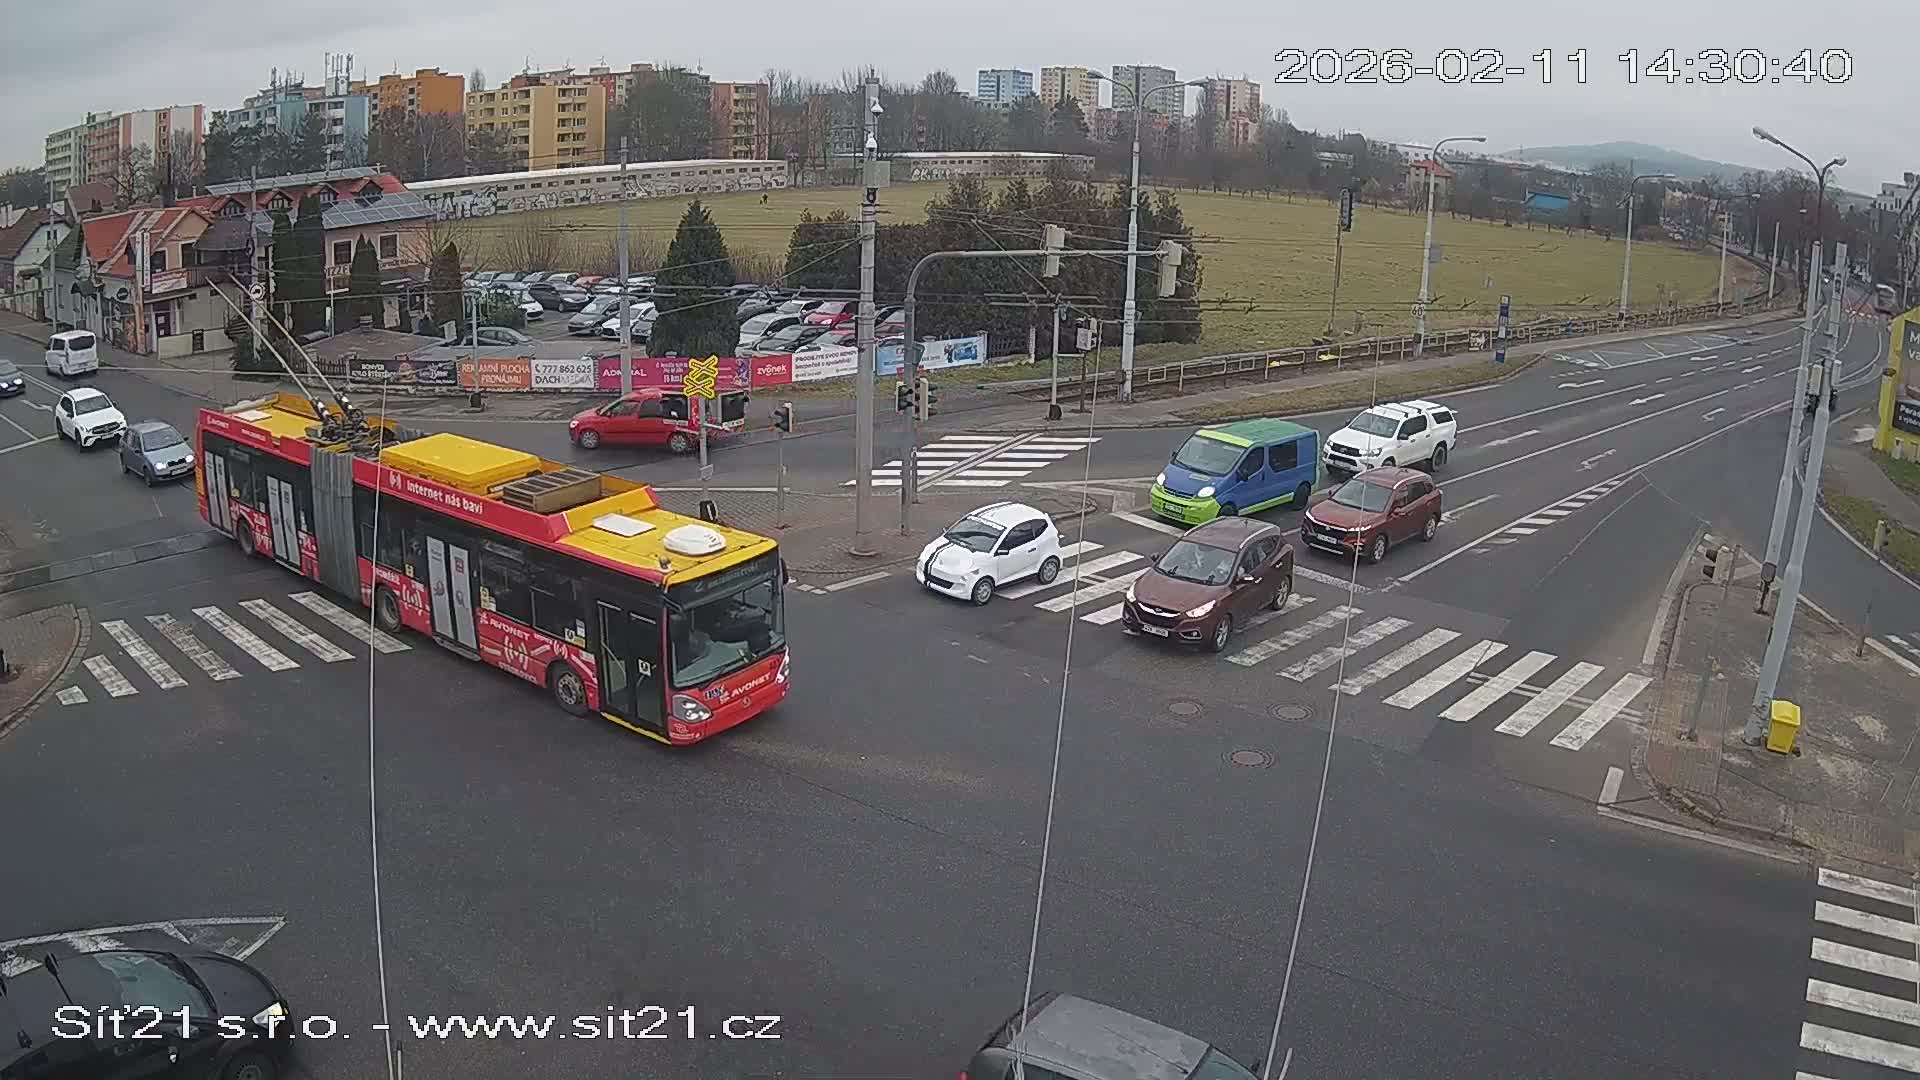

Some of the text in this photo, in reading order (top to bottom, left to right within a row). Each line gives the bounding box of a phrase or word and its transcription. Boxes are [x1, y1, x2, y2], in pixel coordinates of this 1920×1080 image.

[462, 363, 499, 373] REKAMNÍ
[501, 364, 530, 373] PLOCHA
[543, 364, 592, 374] 777 862 625
[602, 368, 648, 377] ADMRAL
[756, 363, 788, 377] zvonek
[482, 372, 522, 385] PRONÁJMU
[406, 480, 443, 502] Internet
[444, 493, 461, 508] nás
[489, 618, 530, 640] AVONET
[731, 672, 771, 698] AVONET
